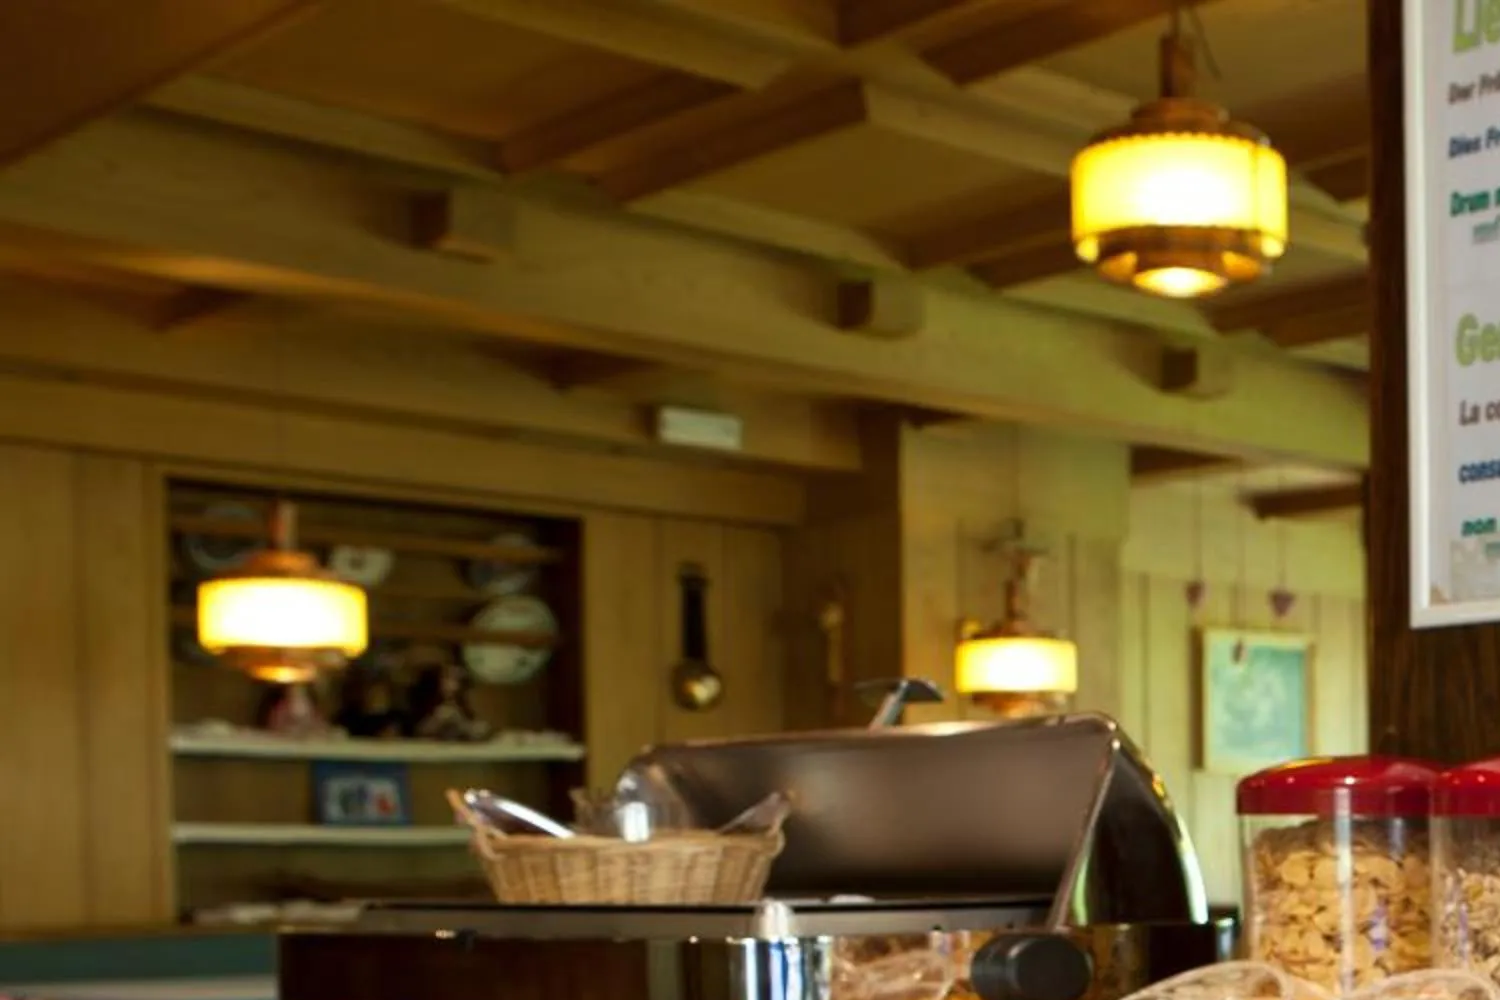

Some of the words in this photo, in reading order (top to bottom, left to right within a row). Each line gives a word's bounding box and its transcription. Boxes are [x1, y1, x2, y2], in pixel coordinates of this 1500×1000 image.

[1448, 83, 1475, 104] Der
[1450, 190, 1490, 217] Drum
[1459, 400, 1480, 427] La
[1461, 516, 1497, 537] non
